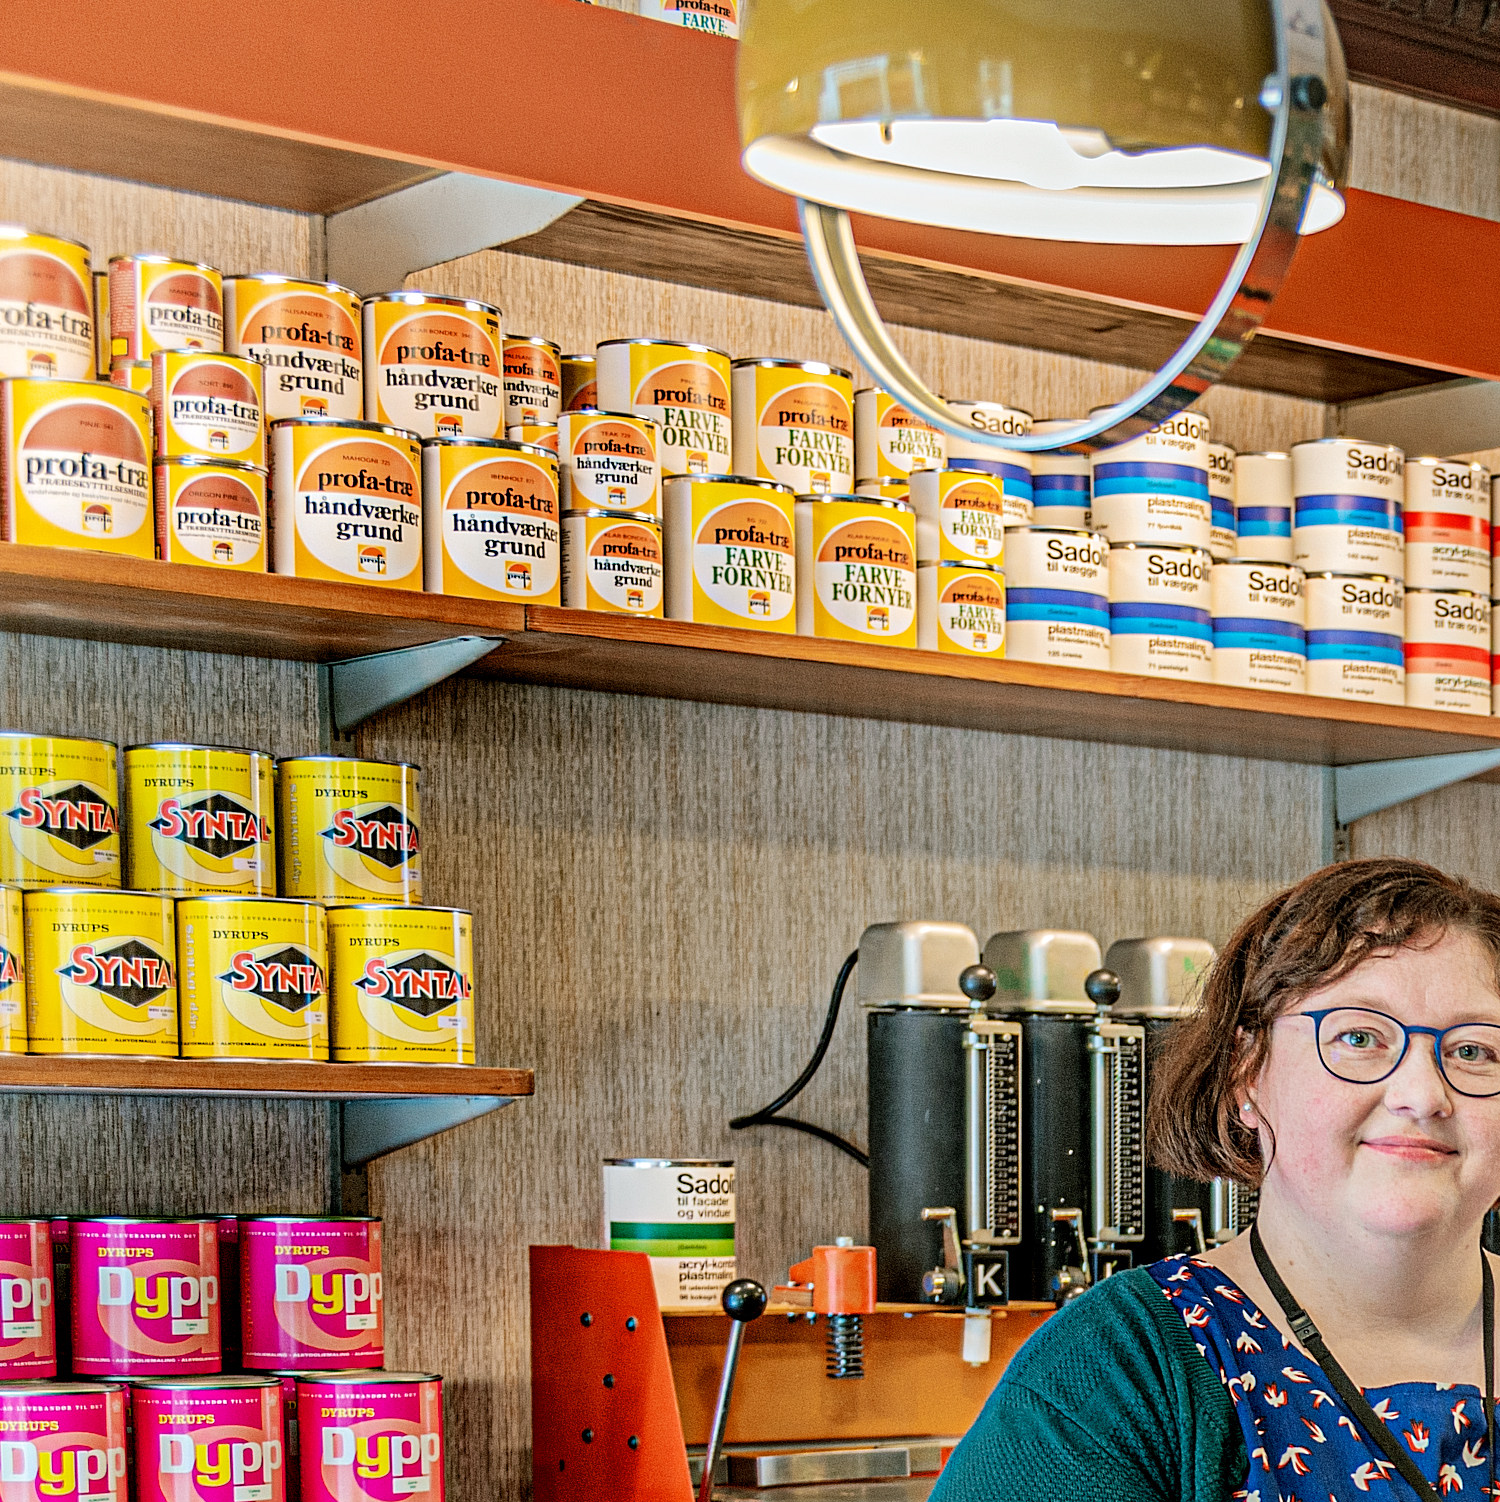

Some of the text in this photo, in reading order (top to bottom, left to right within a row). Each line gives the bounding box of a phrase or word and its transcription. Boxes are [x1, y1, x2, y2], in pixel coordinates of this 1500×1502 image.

[683, 12, 728, 34] FARVE-
[261, 322, 354, 351] profa-træ
[397, 341, 491, 368] profa-træ
[280, 373, 345, 396] grund
[386, 368, 499, 398] håndværker
[173, 396, 260, 422] profa-træ
[414, 391, 480, 412] grund
[654, 385, 727, 411] profa-træ
[663, 407, 725, 434] FARVE-
[778, 407, 850, 431] profa-træ
[584, 438, 647, 456] profa-træ
[661, 423, 730, 457] ORNYER
[788, 429, 847, 453] FARVE-
[342, 454, 379, 464] MAHOGNI
[577, 457, 653, 476] håndværker
[776, 447, 851, 476] FORNYER
[26, 452, 149, 491] profa-træ
[317, 470, 414, 497] profa-træ
[595, 472, 639, 486] grund
[305, 495, 420, 527] håndværker
[466, 489, 555, 515] profa-træ
[177, 508, 262, 533] profa-træ
[336, 520, 403, 543] grund
[452, 514, 559, 544] håndværker
[484, 538, 547, 560] grund
[715, 525, 790, 549] profa-træ
[725, 547, 787, 573] FARVE-
[835, 543, 909, 565] profa-træ
[711, 566, 792, 595] FORNYER
[844, 564, 906, 588] FARVE-
[832, 583, 913, 611] FORNYER
[144, 778, 194, 788] DYRUPS
[315, 788, 369, 799] DYRUPS
[159, 798, 271, 843] SYNTAL
[52, 923, 110, 933] DYRUPS
[213, 930, 269, 941] DYRUPS
[349, 937, 400, 947] DYRUPS
[365, 957, 471, 1000] SYNTAL
[677, 1196, 730, 1207] til facader
[677, 1209, 694, 1220] og
[97, 1246, 155, 1258] DYRUPS
[274, 1245, 330, 1256] DYRUPS
[275, 1263, 382, 1315] Dypp
[978, 1262, 1002, 1297] K
[98, 1266, 218, 1320] Dypp
[158, 1414, 215, 1425] DYRUPS
[321, 1407, 375, 1418] DYRUPS
[0, 1420, 59, 1432] DYRUPS
[159, 1433, 282, 1487] Dypp
[322, 1426, 440, 1479] Dypp
[0, 1441, 126, 1496] Dypp
